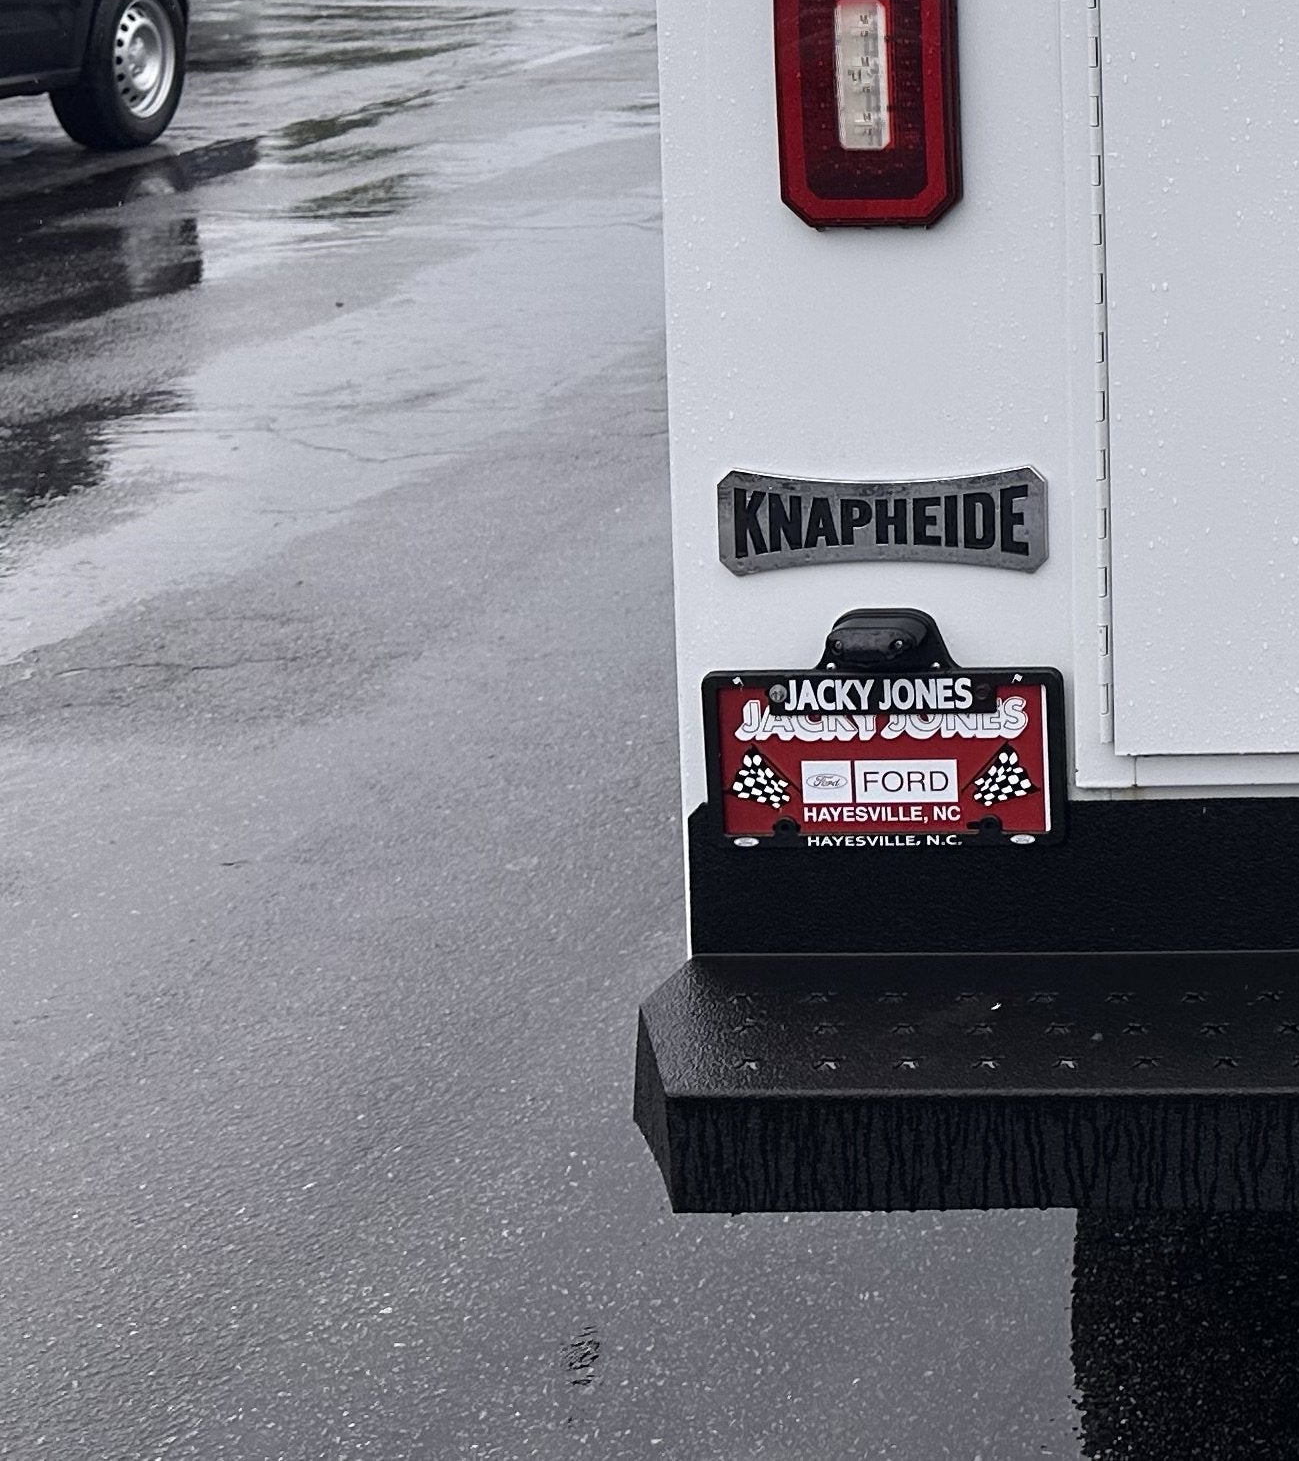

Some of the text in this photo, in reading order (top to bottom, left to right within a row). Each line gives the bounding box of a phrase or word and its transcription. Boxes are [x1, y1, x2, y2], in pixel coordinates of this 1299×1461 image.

[733, 484, 1029, 559] KNAPHEIDE
[784, 677, 973, 711] JACKY JONES
[812, 774, 841, 788] Ford
[863, 771, 949, 793] FORD
[803, 805, 961, 823] HAYESVILLE, NC
